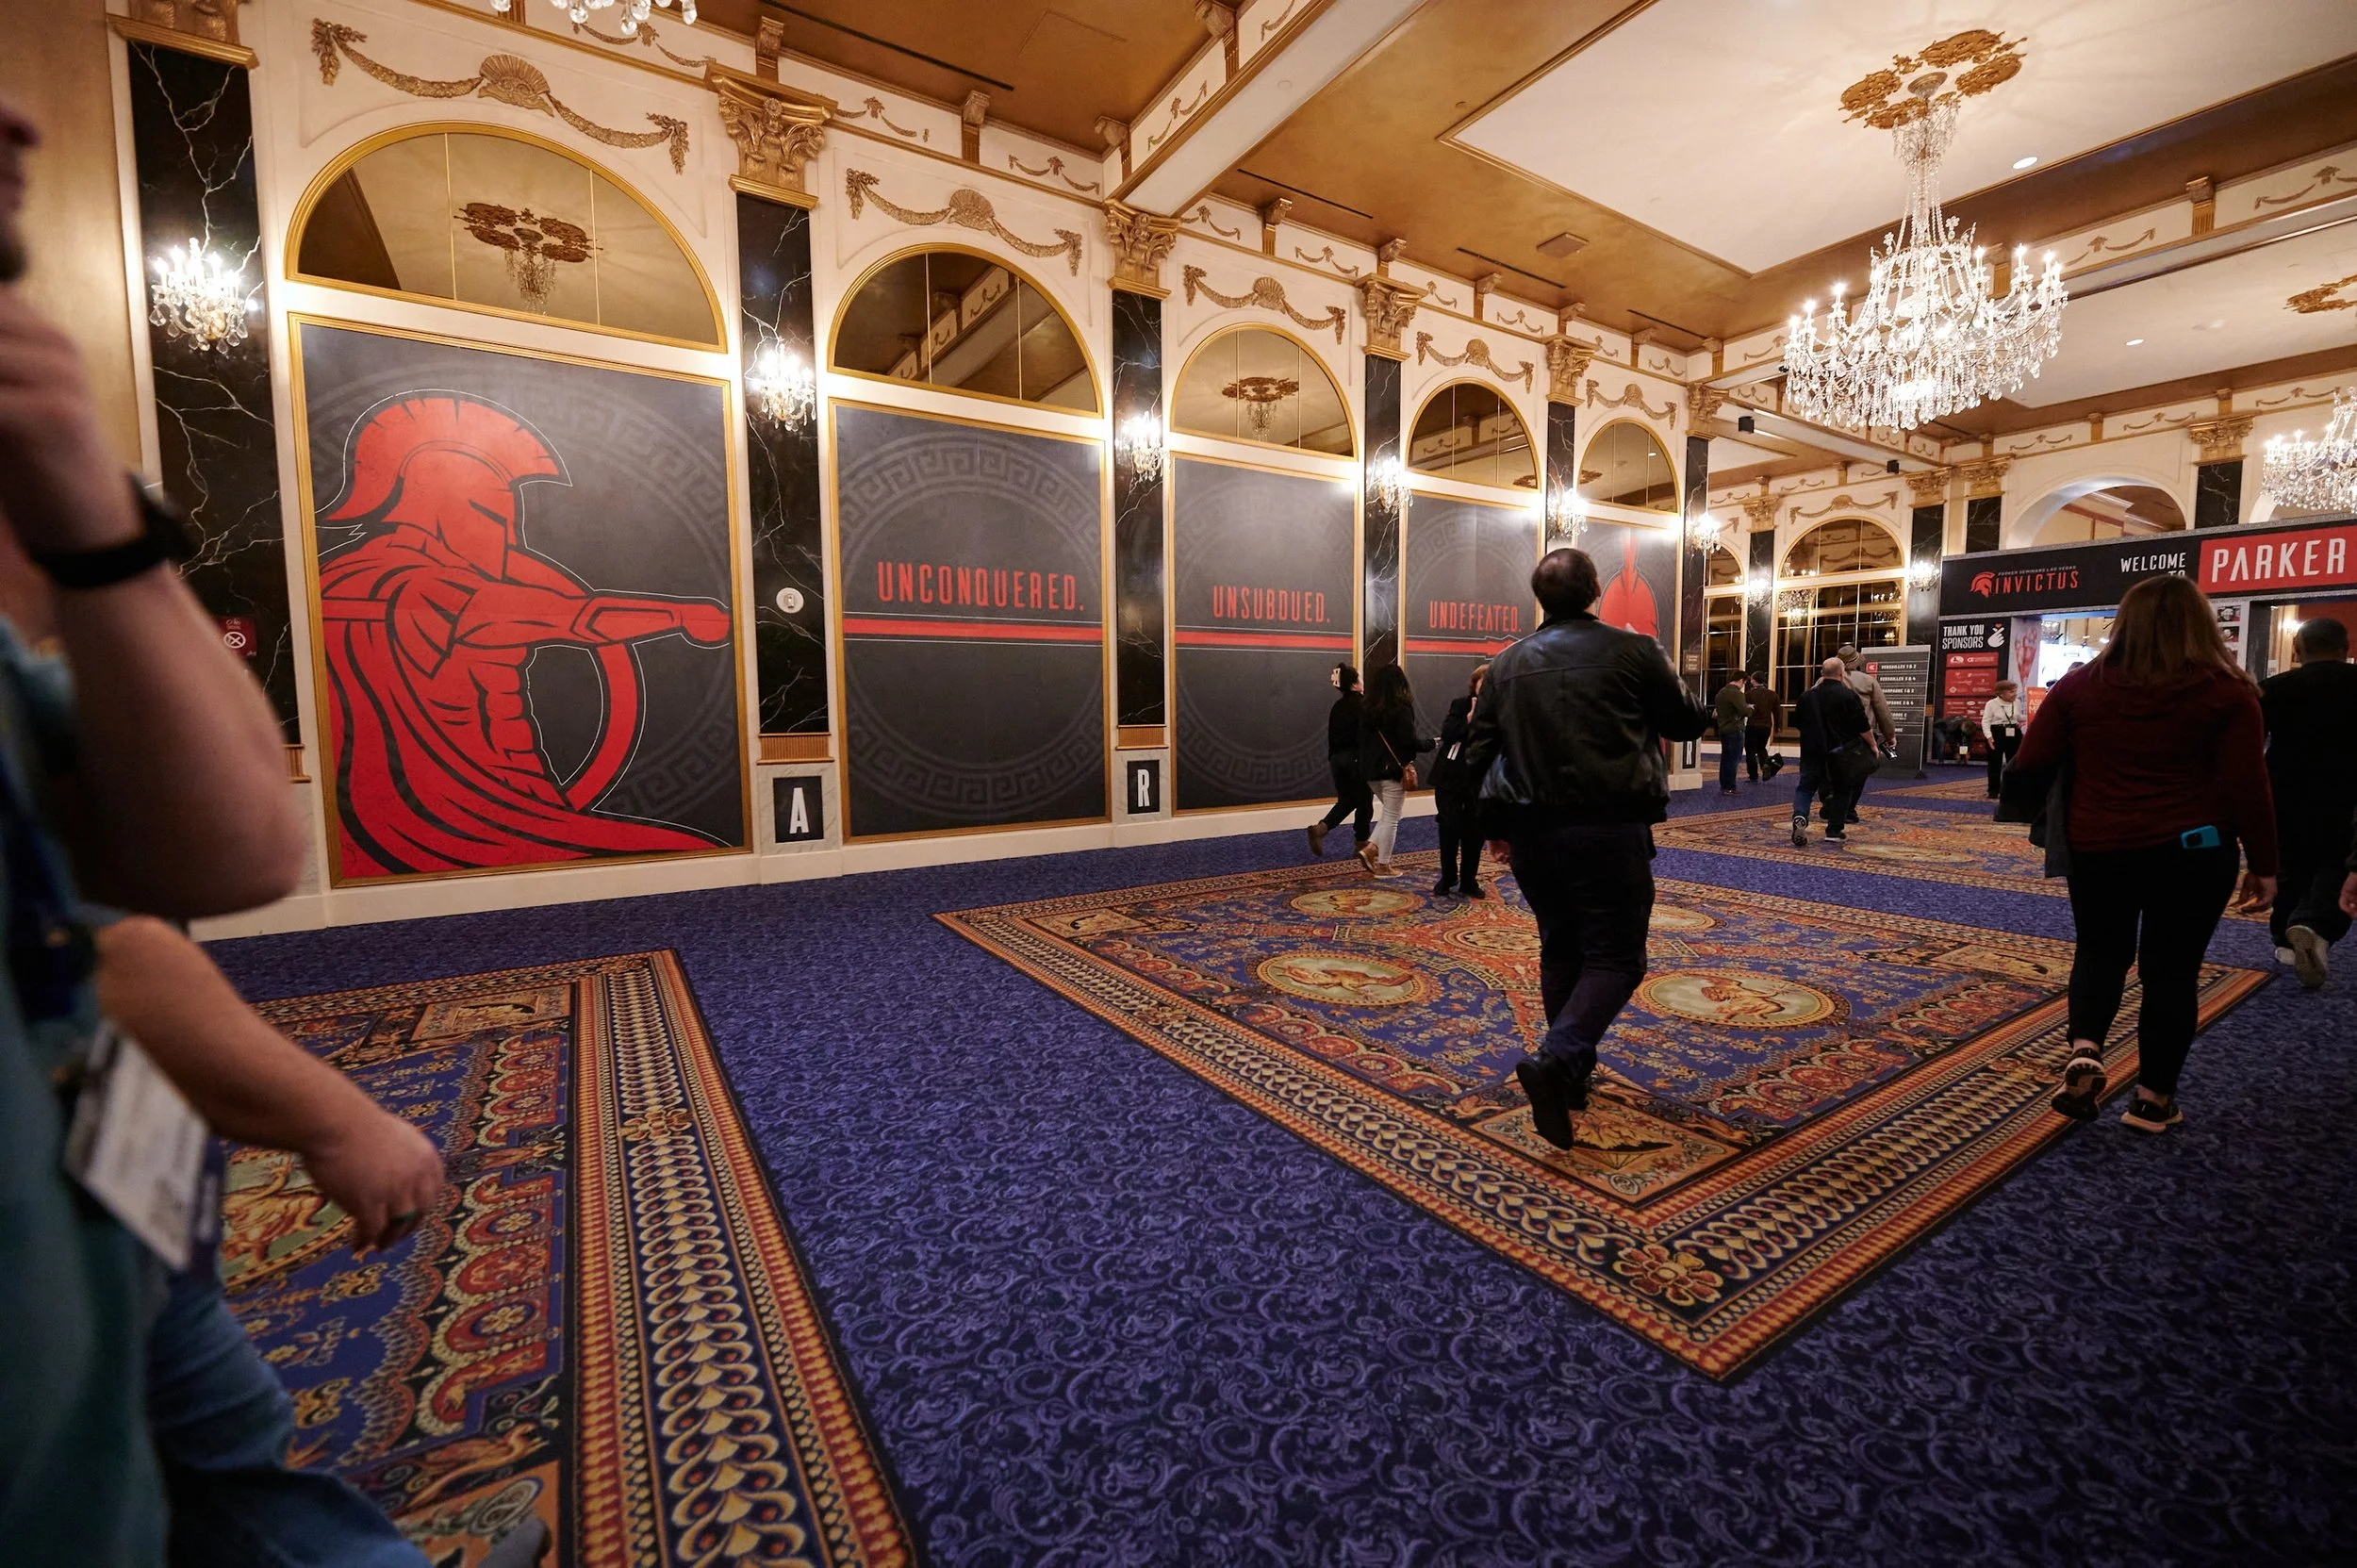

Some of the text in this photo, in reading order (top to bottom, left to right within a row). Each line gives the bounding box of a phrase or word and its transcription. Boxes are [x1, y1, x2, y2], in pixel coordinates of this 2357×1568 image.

[2120, 552, 2186, 573] WELCOME
[2211, 537, 2347, 584] PARKER
[877, 561, 1085, 611] UNCONQUERED.
[1995, 570, 2079, 594] INVICTUS
[1212, 585, 1330, 624] UNSUBDUED.
[1429, 601, 1522, 633] UNDEFEATED.
[1942, 636, 1984, 650] SPONSORS
[1943, 624, 1985, 636] THANK YOU
[1687, 741, 1692, 765] R
[1137, 769, 1149, 807] R
[788, 786, 808, 834] A
